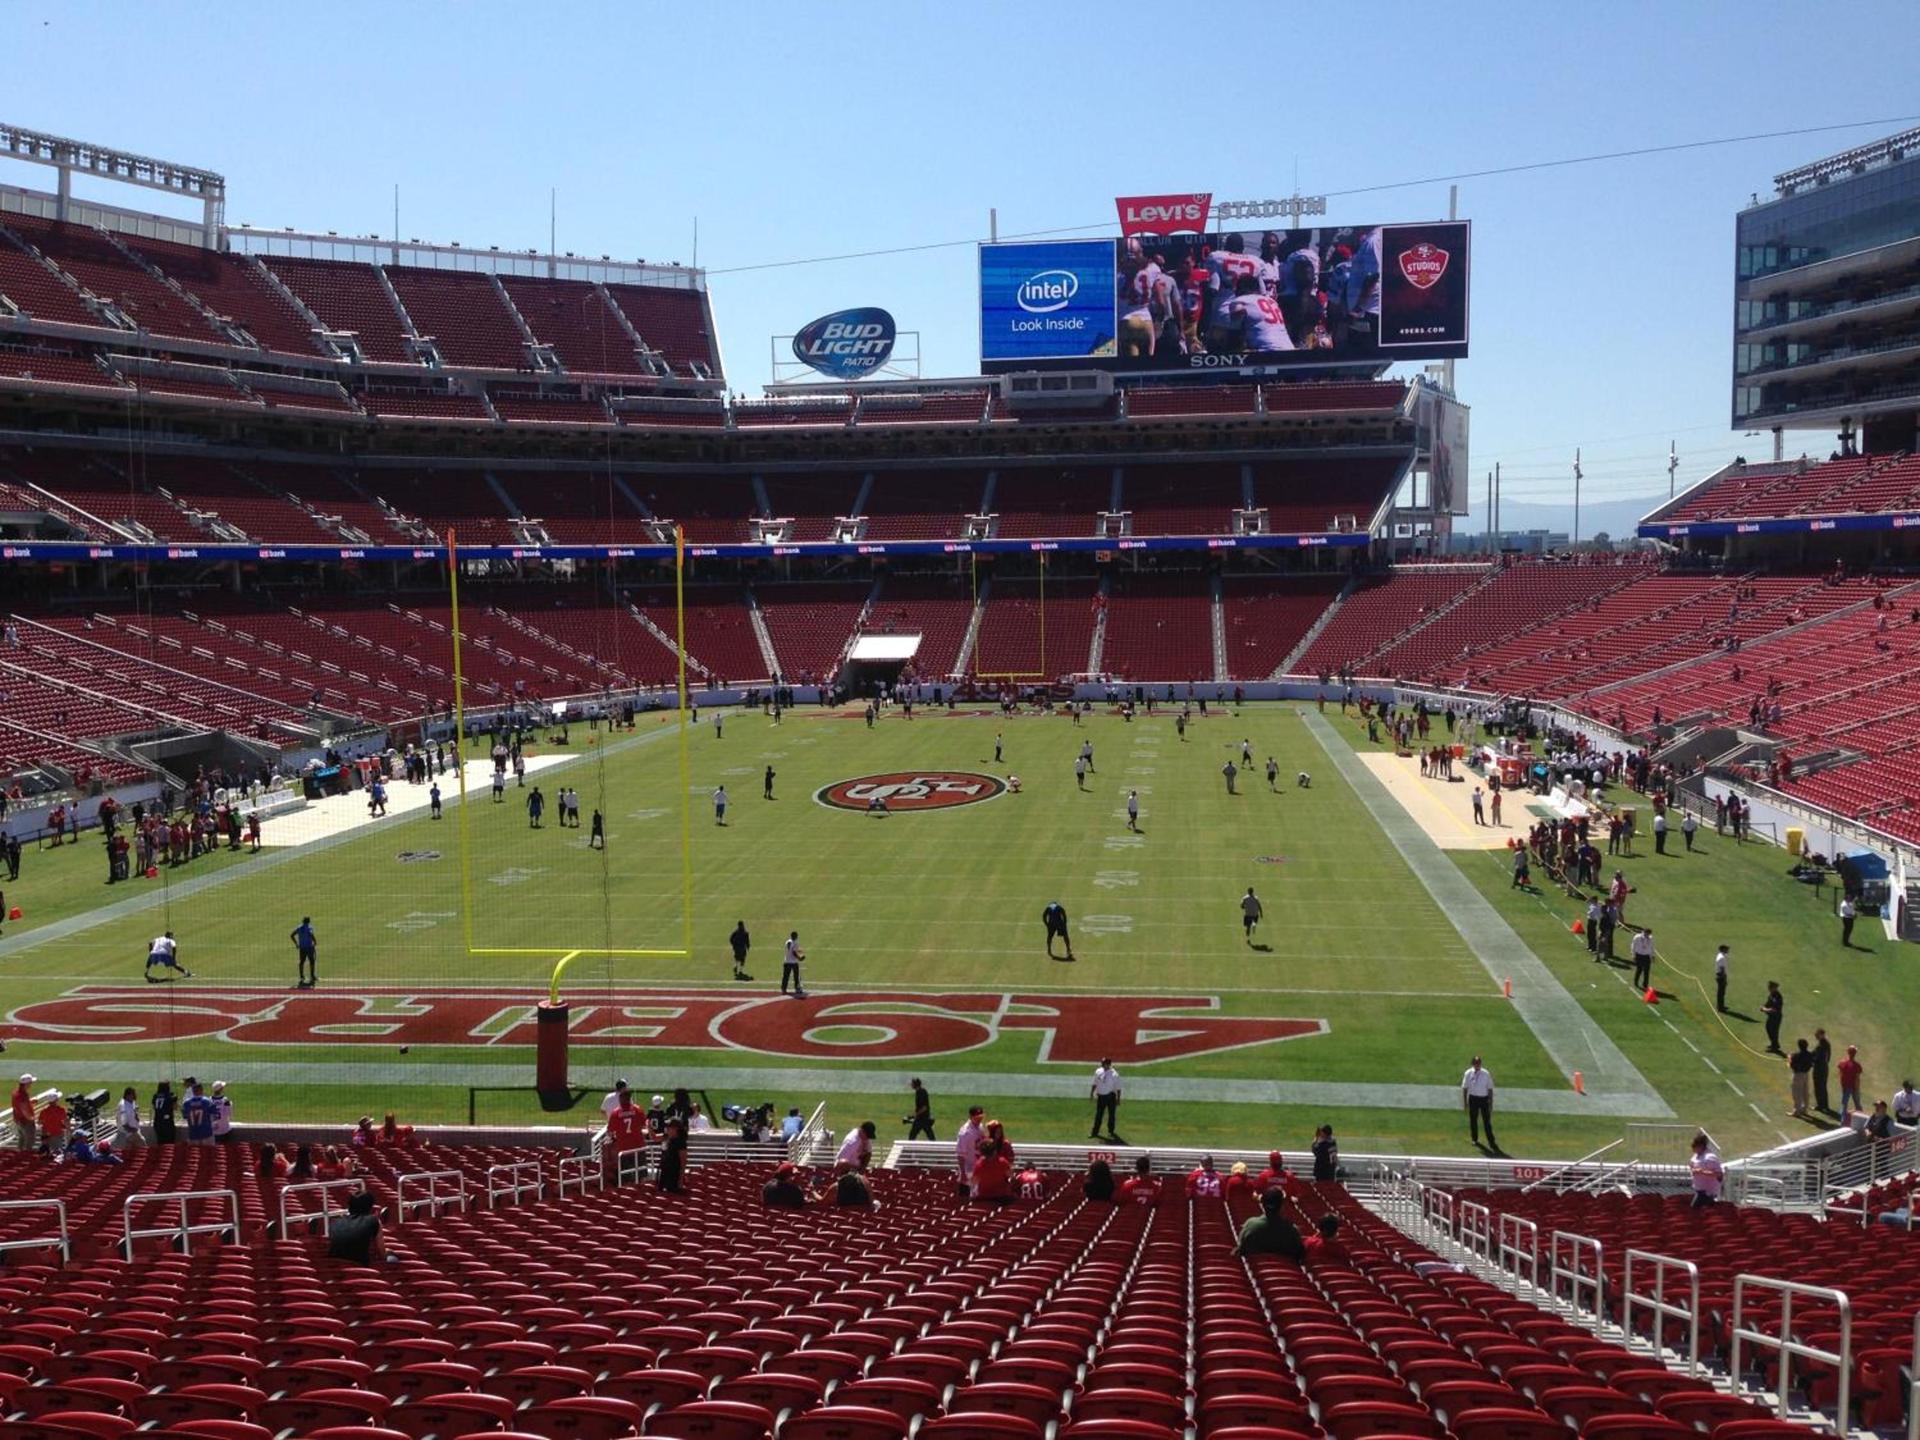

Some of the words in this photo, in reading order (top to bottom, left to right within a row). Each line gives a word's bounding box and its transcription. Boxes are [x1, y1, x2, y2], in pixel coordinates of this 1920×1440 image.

[1219, 196, 1326, 220] STADIUM
[1407, 262, 1440, 273] STUDIOS
[1025, 279, 1068, 299] intel
[822, 323, 883, 339] BUD
[1012, 319, 1043, 331] Look
[1400, 326, 1446, 334] 49ERS.COM
[808, 339, 891, 355] LIGHT
[842, 357, 875, 366] PATIO
[1190, 354, 1249, 367] SONY
[0, 985, 1331, 1065] 49ERS
[624, 1118, 632, 1134] 7
[1091, 1153, 1114, 1163] 102
[1516, 1167, 1541, 1179] 101
